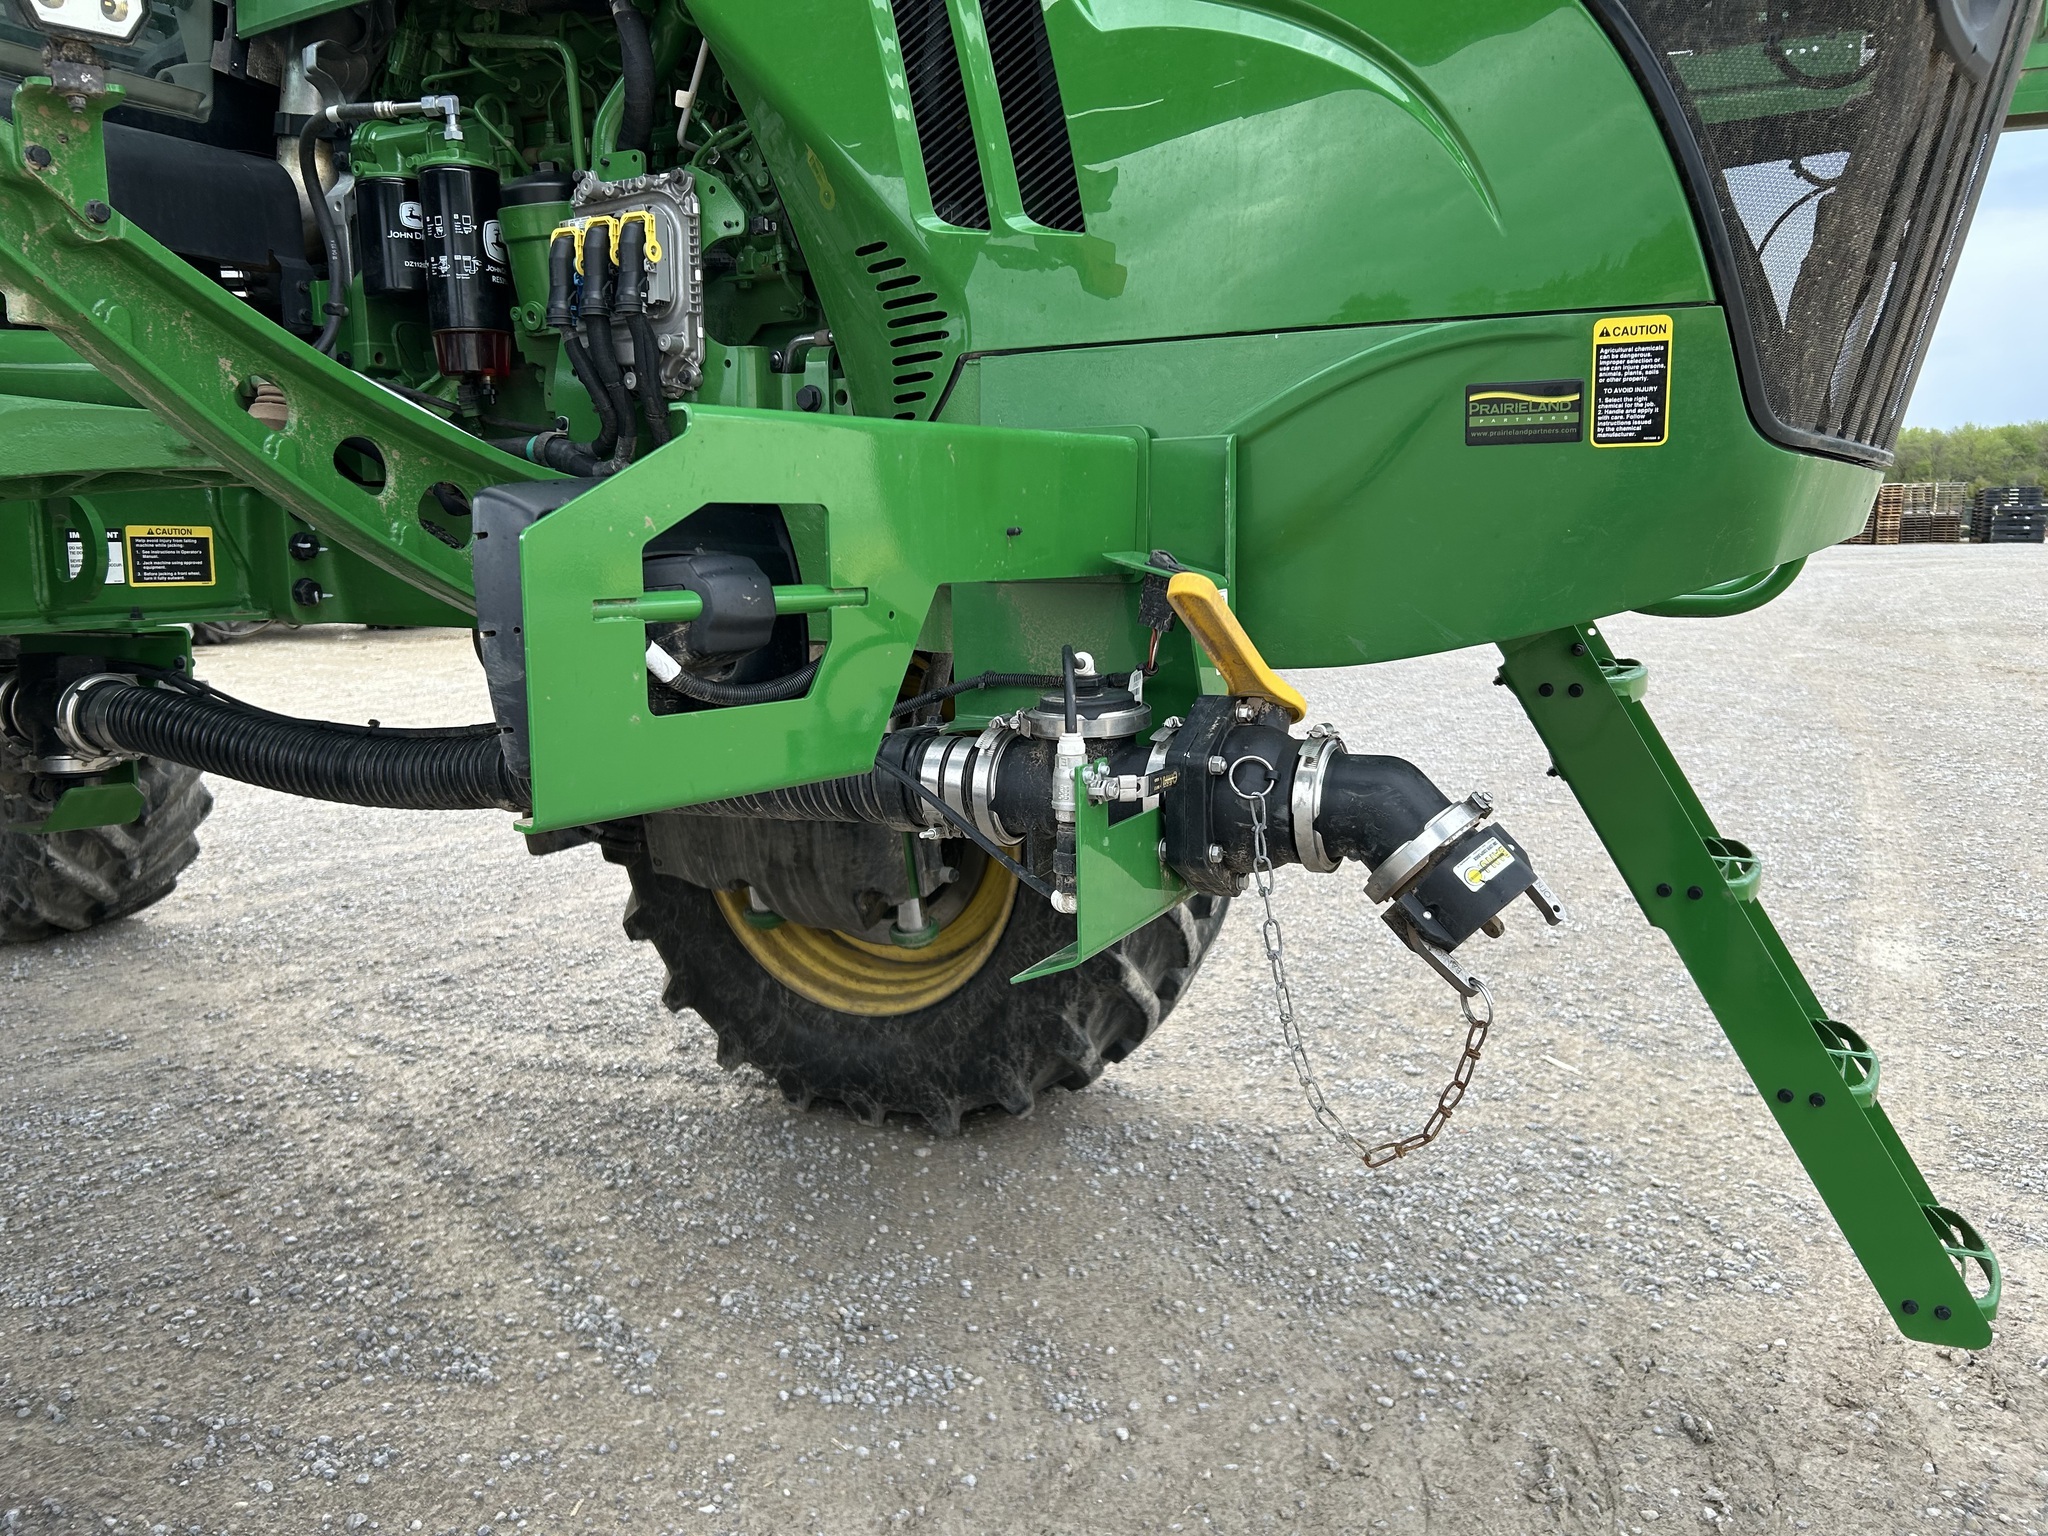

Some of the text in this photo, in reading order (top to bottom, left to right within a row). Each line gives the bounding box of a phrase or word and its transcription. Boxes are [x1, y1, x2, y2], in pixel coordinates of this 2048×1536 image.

[387, 230, 413, 239] JOHN
[1612, 324, 1667, 337] CAUTION
[1599, 346, 1634, 355] Agricultural
[1619, 351, 1652, 360] dangerous.
[1599, 359, 1626, 367] Improper
[1622, 364, 1639, 372] injure
[1644, 401, 1656, 409] job.
[1479, 415, 1568, 424] PARTNERS
[1471, 427, 1577, 437] www.prairielandpartners.com
